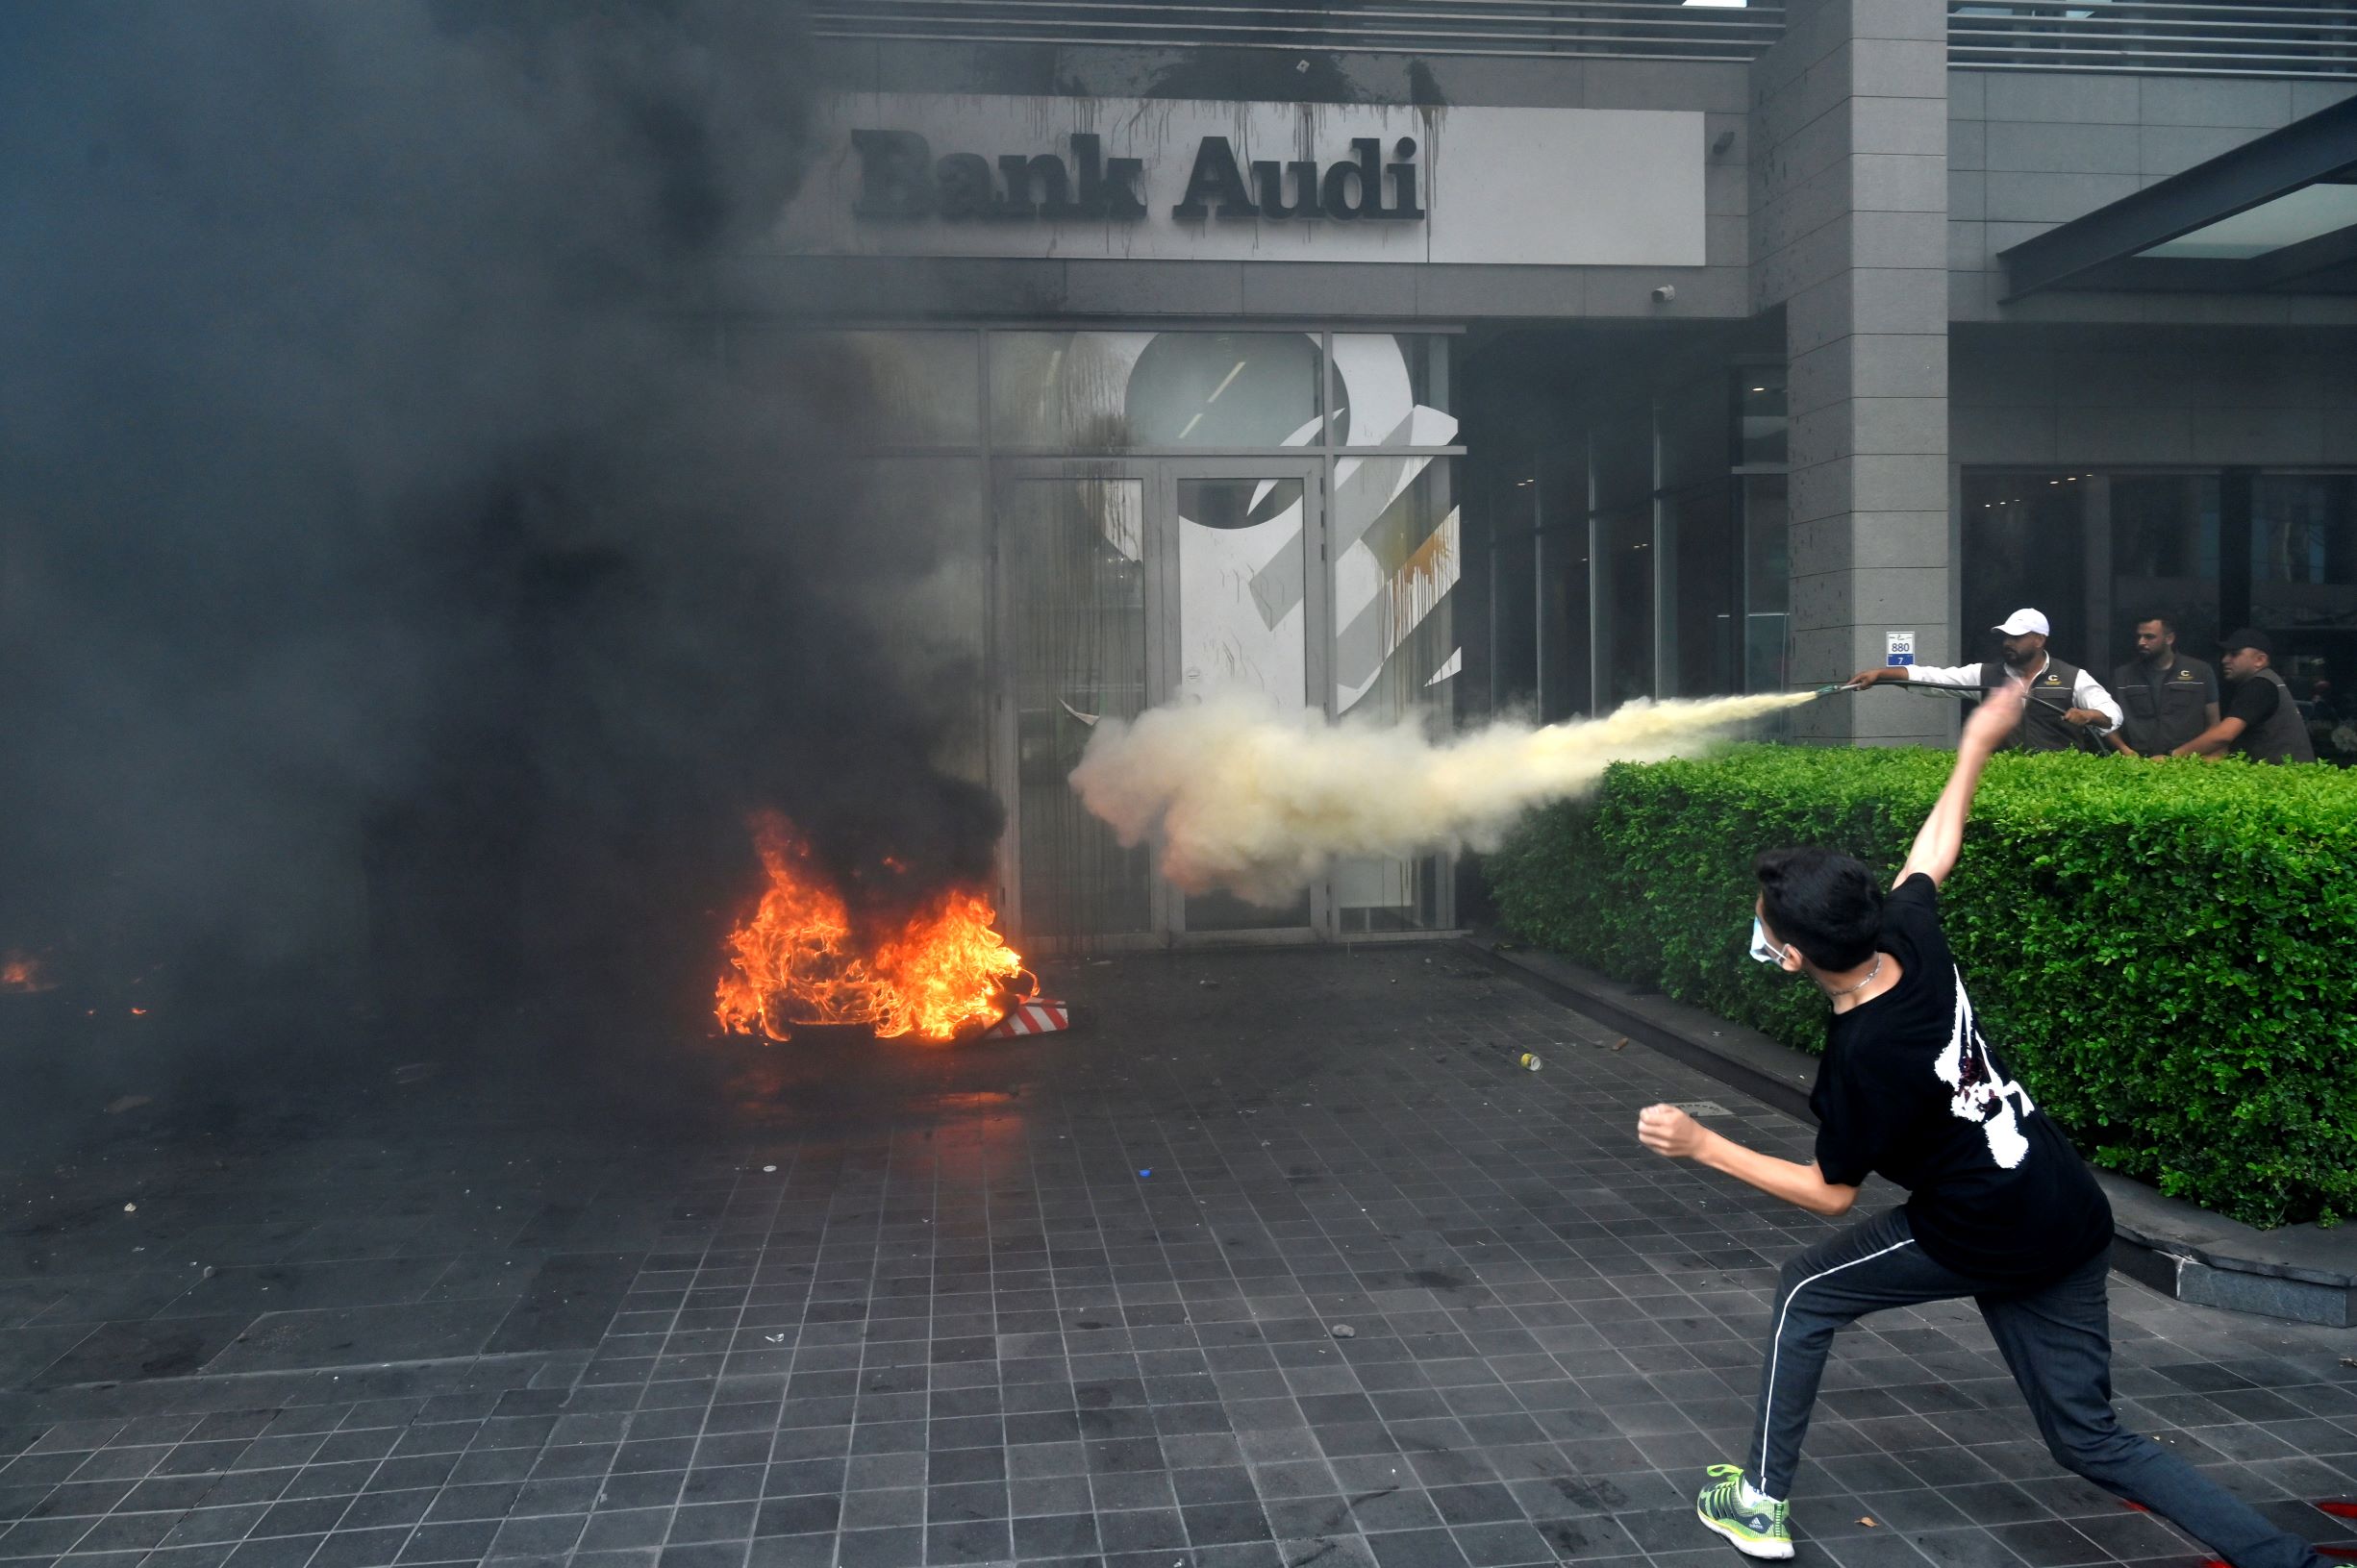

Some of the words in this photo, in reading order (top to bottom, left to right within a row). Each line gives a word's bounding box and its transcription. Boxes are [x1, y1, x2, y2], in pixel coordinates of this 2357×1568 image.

[851, 128, 1147, 217] Bank
[1172, 136, 1425, 220] Audi
[1892, 643, 1910, 652] 880
